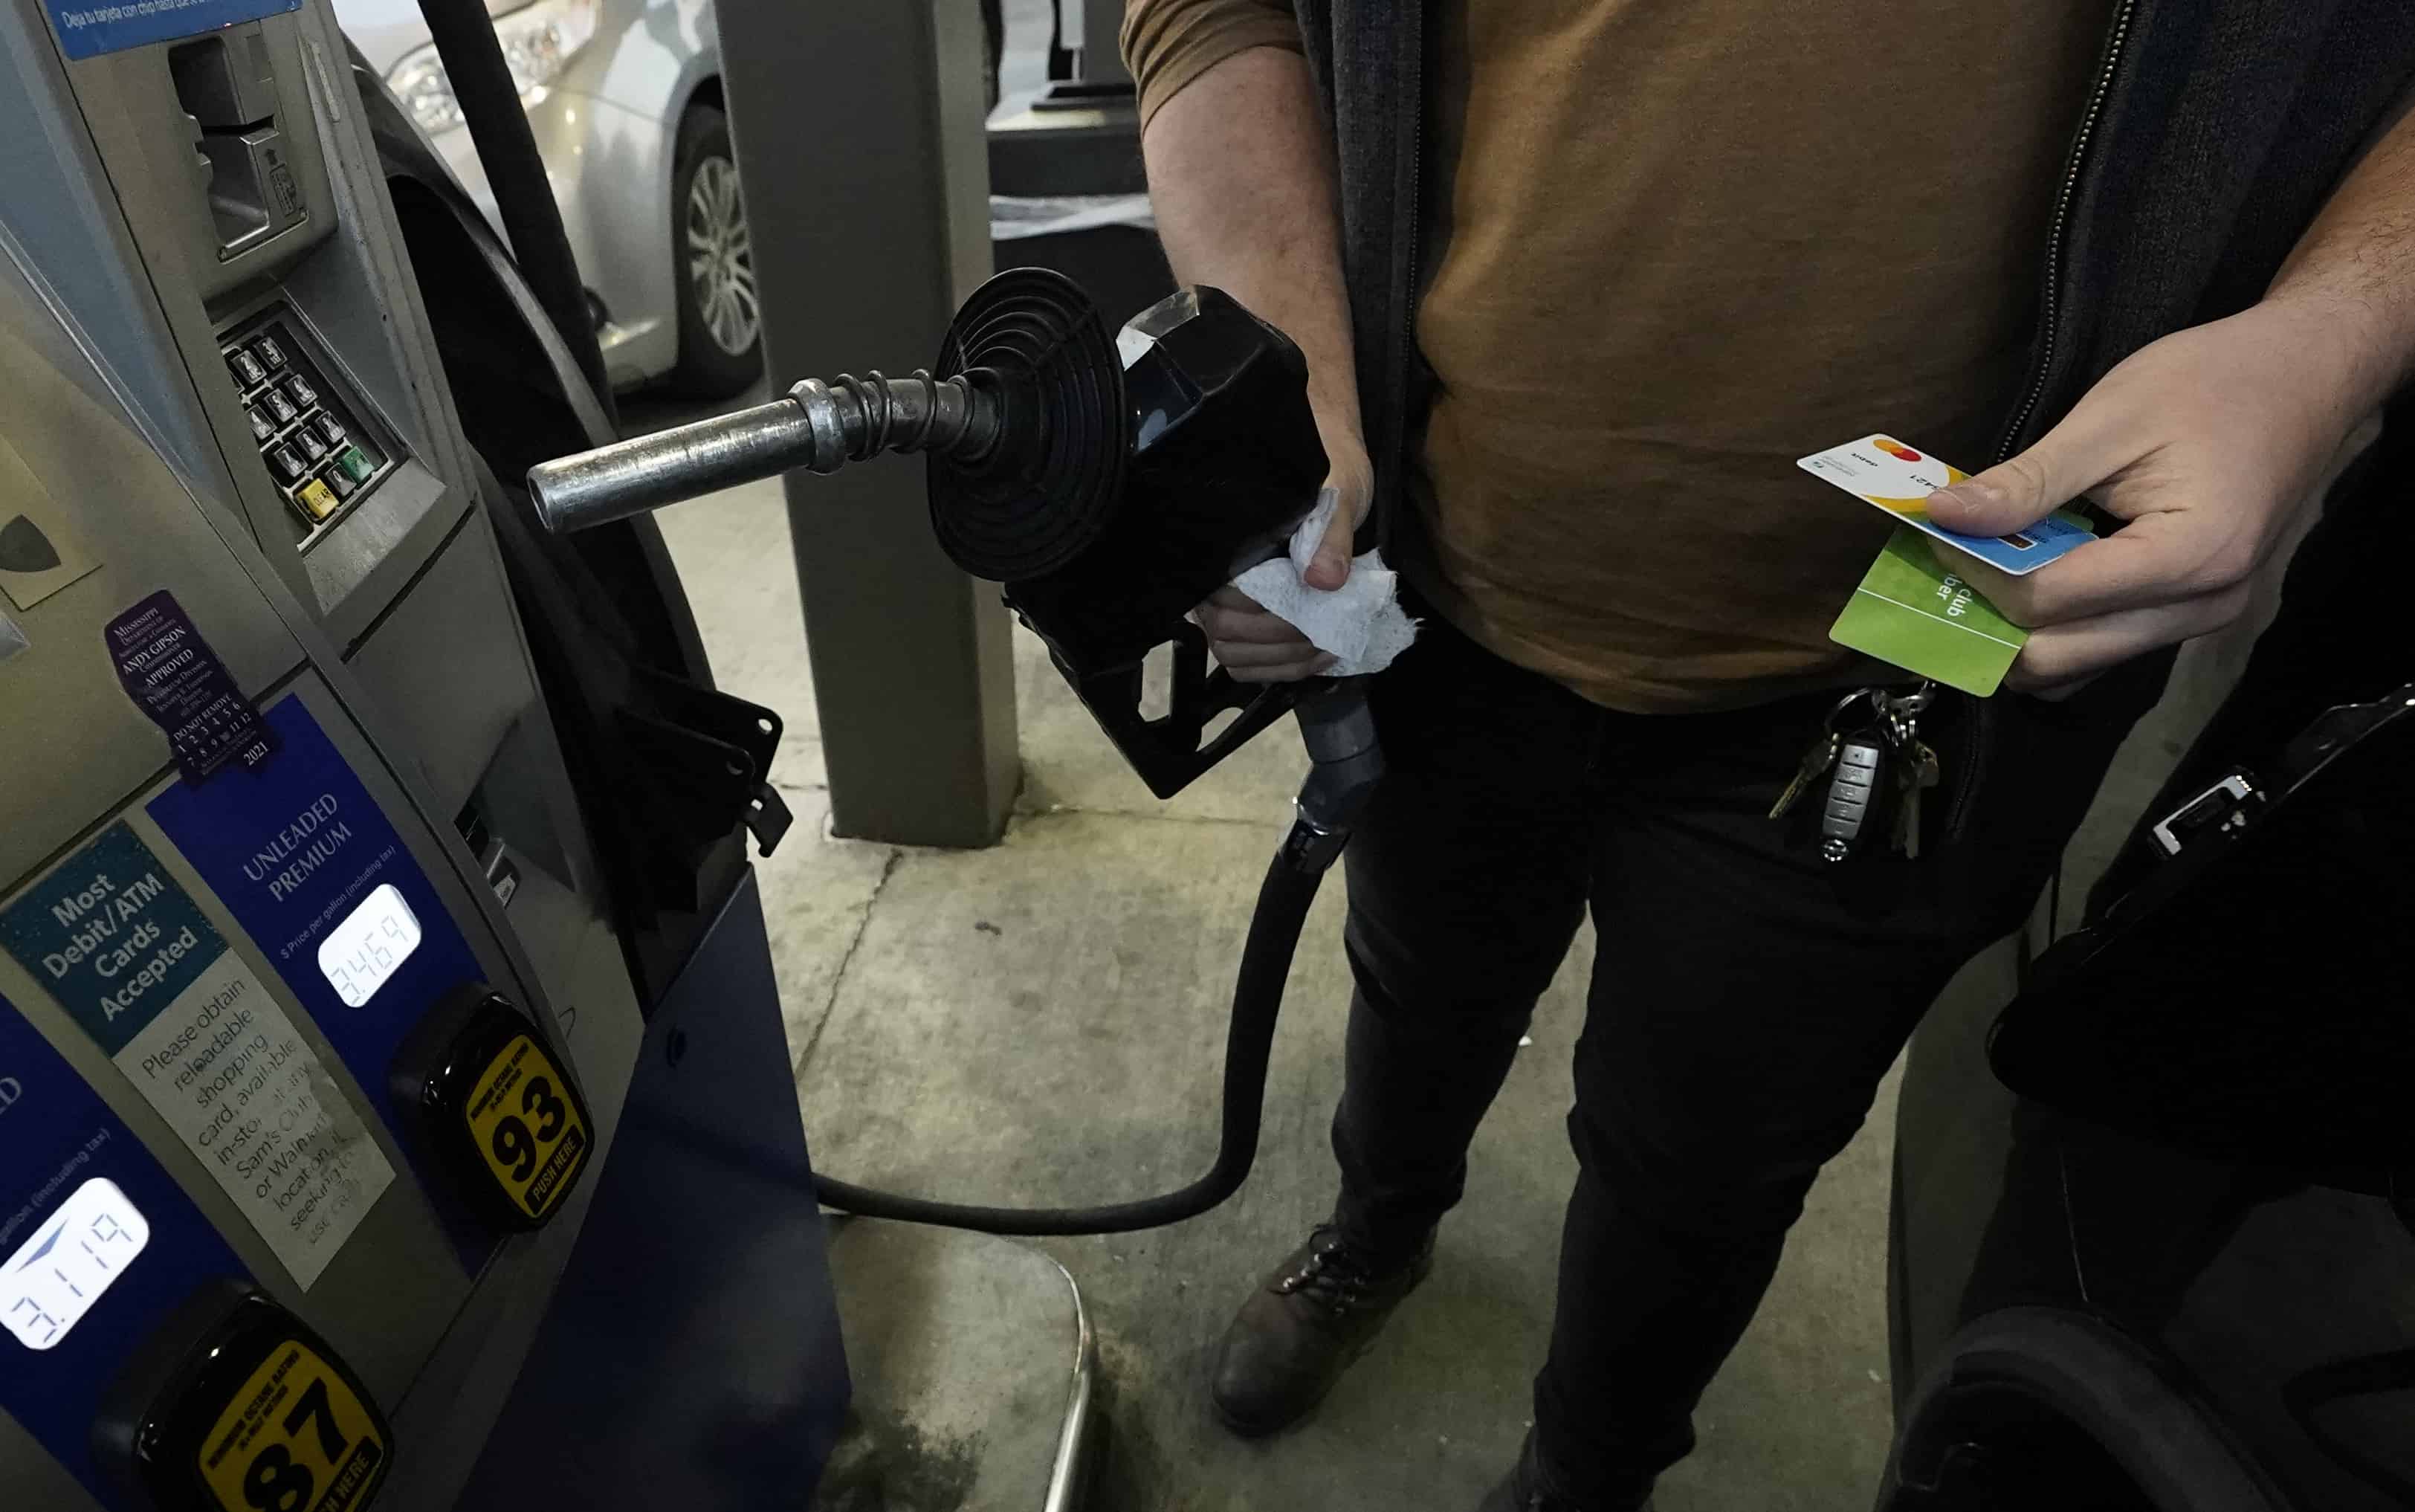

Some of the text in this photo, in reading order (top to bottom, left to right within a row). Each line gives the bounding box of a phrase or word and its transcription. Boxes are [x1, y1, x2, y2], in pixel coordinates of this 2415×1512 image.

[1850, 452, 1879, 467] debit
[1936, 573, 1963, 601] ber
[121, 649, 151, 676] ANDY
[149, 624, 187, 656] GIPSON
[144, 648, 195, 688] APPROVED
[172, 726, 187, 743] DO
[186, 716, 203, 731] NOT
[201, 694, 233, 720] REMOVE
[239, 711, 253, 726] 12
[242, 740, 269, 766] 2021
[243, 792, 339, 882] UNLEADED
[268, 820, 352, 902] PREMIUM
[42, 872, 167, 980] Debit/ATM
[51, 873, 117, 928] Most
[287, 929, 310, 952] Price
[308, 915, 324, 934] per
[323, 894, 347, 920] gallon
[344, 859, 383, 897] (including
[94, 920, 161, 978] Cards
[100, 925, 199, 1022] Accepted
[141, 977, 246, 1079] Please obtain
[172, 1008, 254, 1092] reloadable
[196, 1034, 269, 1110] shopping
[84, 1126, 112, 1152] tax)
[236, 1127, 282, 1180] Sam's
[492, 1076, 566, 1183] 93
[256, 1175, 274, 1200] or
[531, 1135, 578, 1202] PUSH HERE
[244, 1376, 349, 1512] 87
[334, 1450, 369, 1499] HERE
